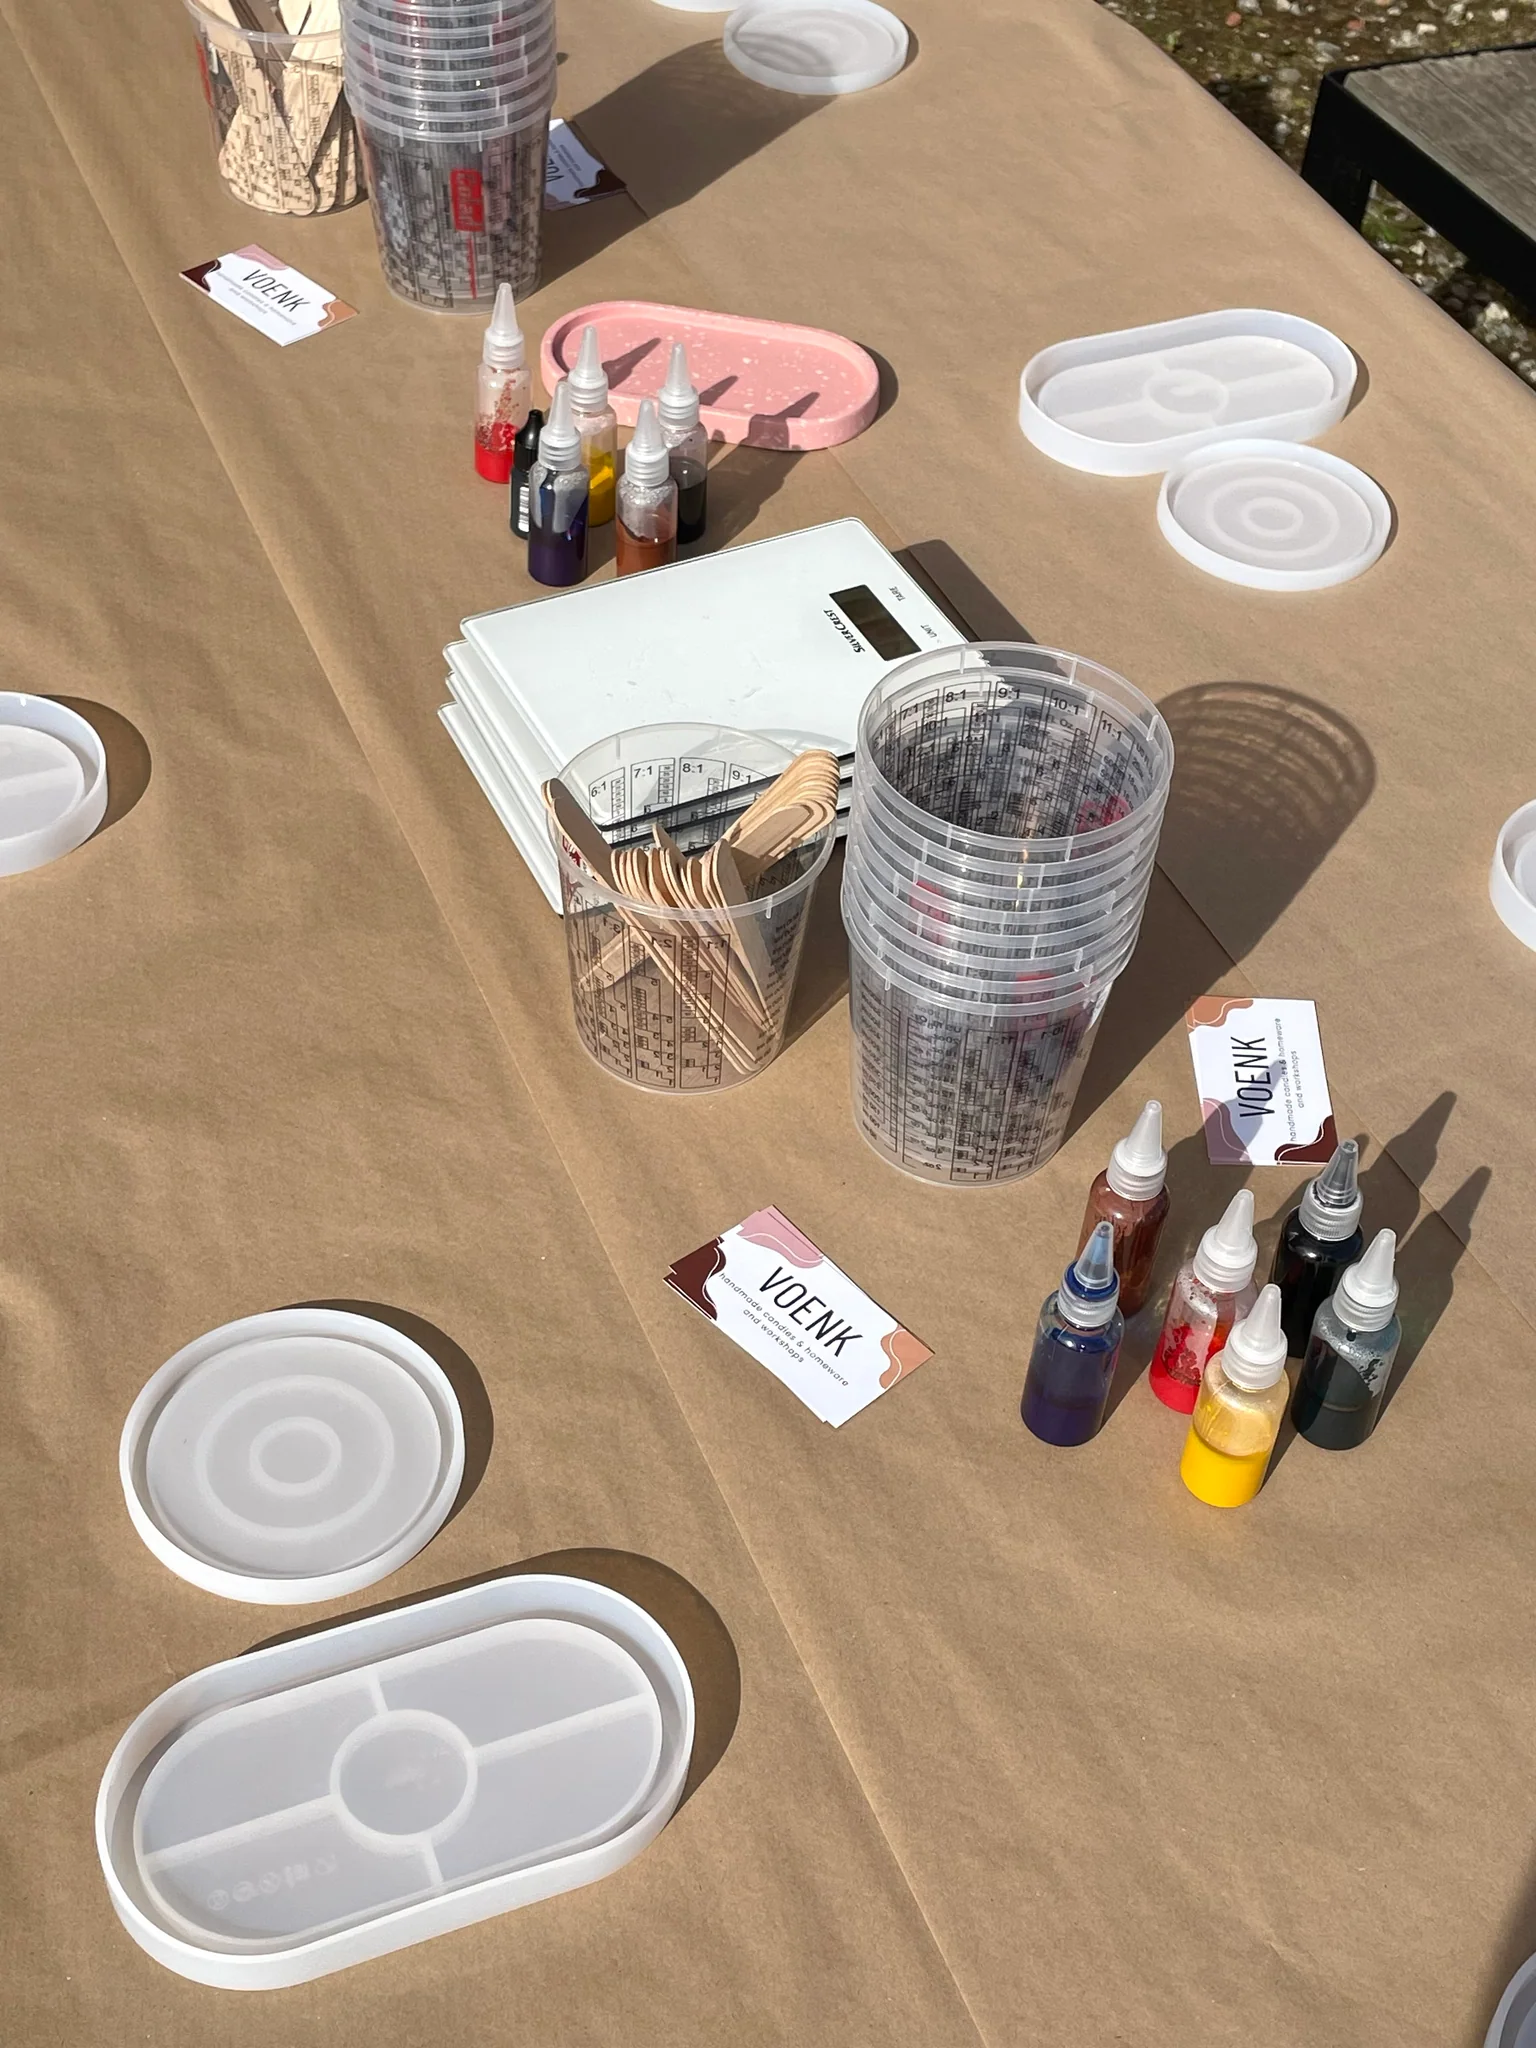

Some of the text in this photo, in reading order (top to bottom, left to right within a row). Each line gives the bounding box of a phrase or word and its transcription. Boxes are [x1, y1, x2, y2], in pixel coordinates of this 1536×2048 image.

[242, 269, 311, 312] VOENK
[888, 586, 906, 602] TARE
[920, 624, 938, 639] UNIT
[945, 689, 967, 703] 8:1
[998, 687, 1020, 699] 9:1
[902, 703, 919, 720] 7:1
[1052, 697, 1079, 715] 10:1
[1102, 719, 1122, 741] 11:1
[634, 766, 652, 778] 7:1
[682, 763, 703, 773] 8:1
[732, 770, 751, 784] 9:1
[590, 781, 606, 797] 6:1
[1275, 1018, 1286, 1058] homeware
[1230, 1036, 1275, 1118] VOENK
[1281, 1064, 1291, 1098] candles
[1291, 1051, 1305, 1108] and workshops
[1284, 1099, 1296, 1142] handmade
[759, 1266, 862, 1357] VOENK
[719, 1272, 849, 1387] handmade candles & homeware
[743, 1308, 805, 1363] and workshops
